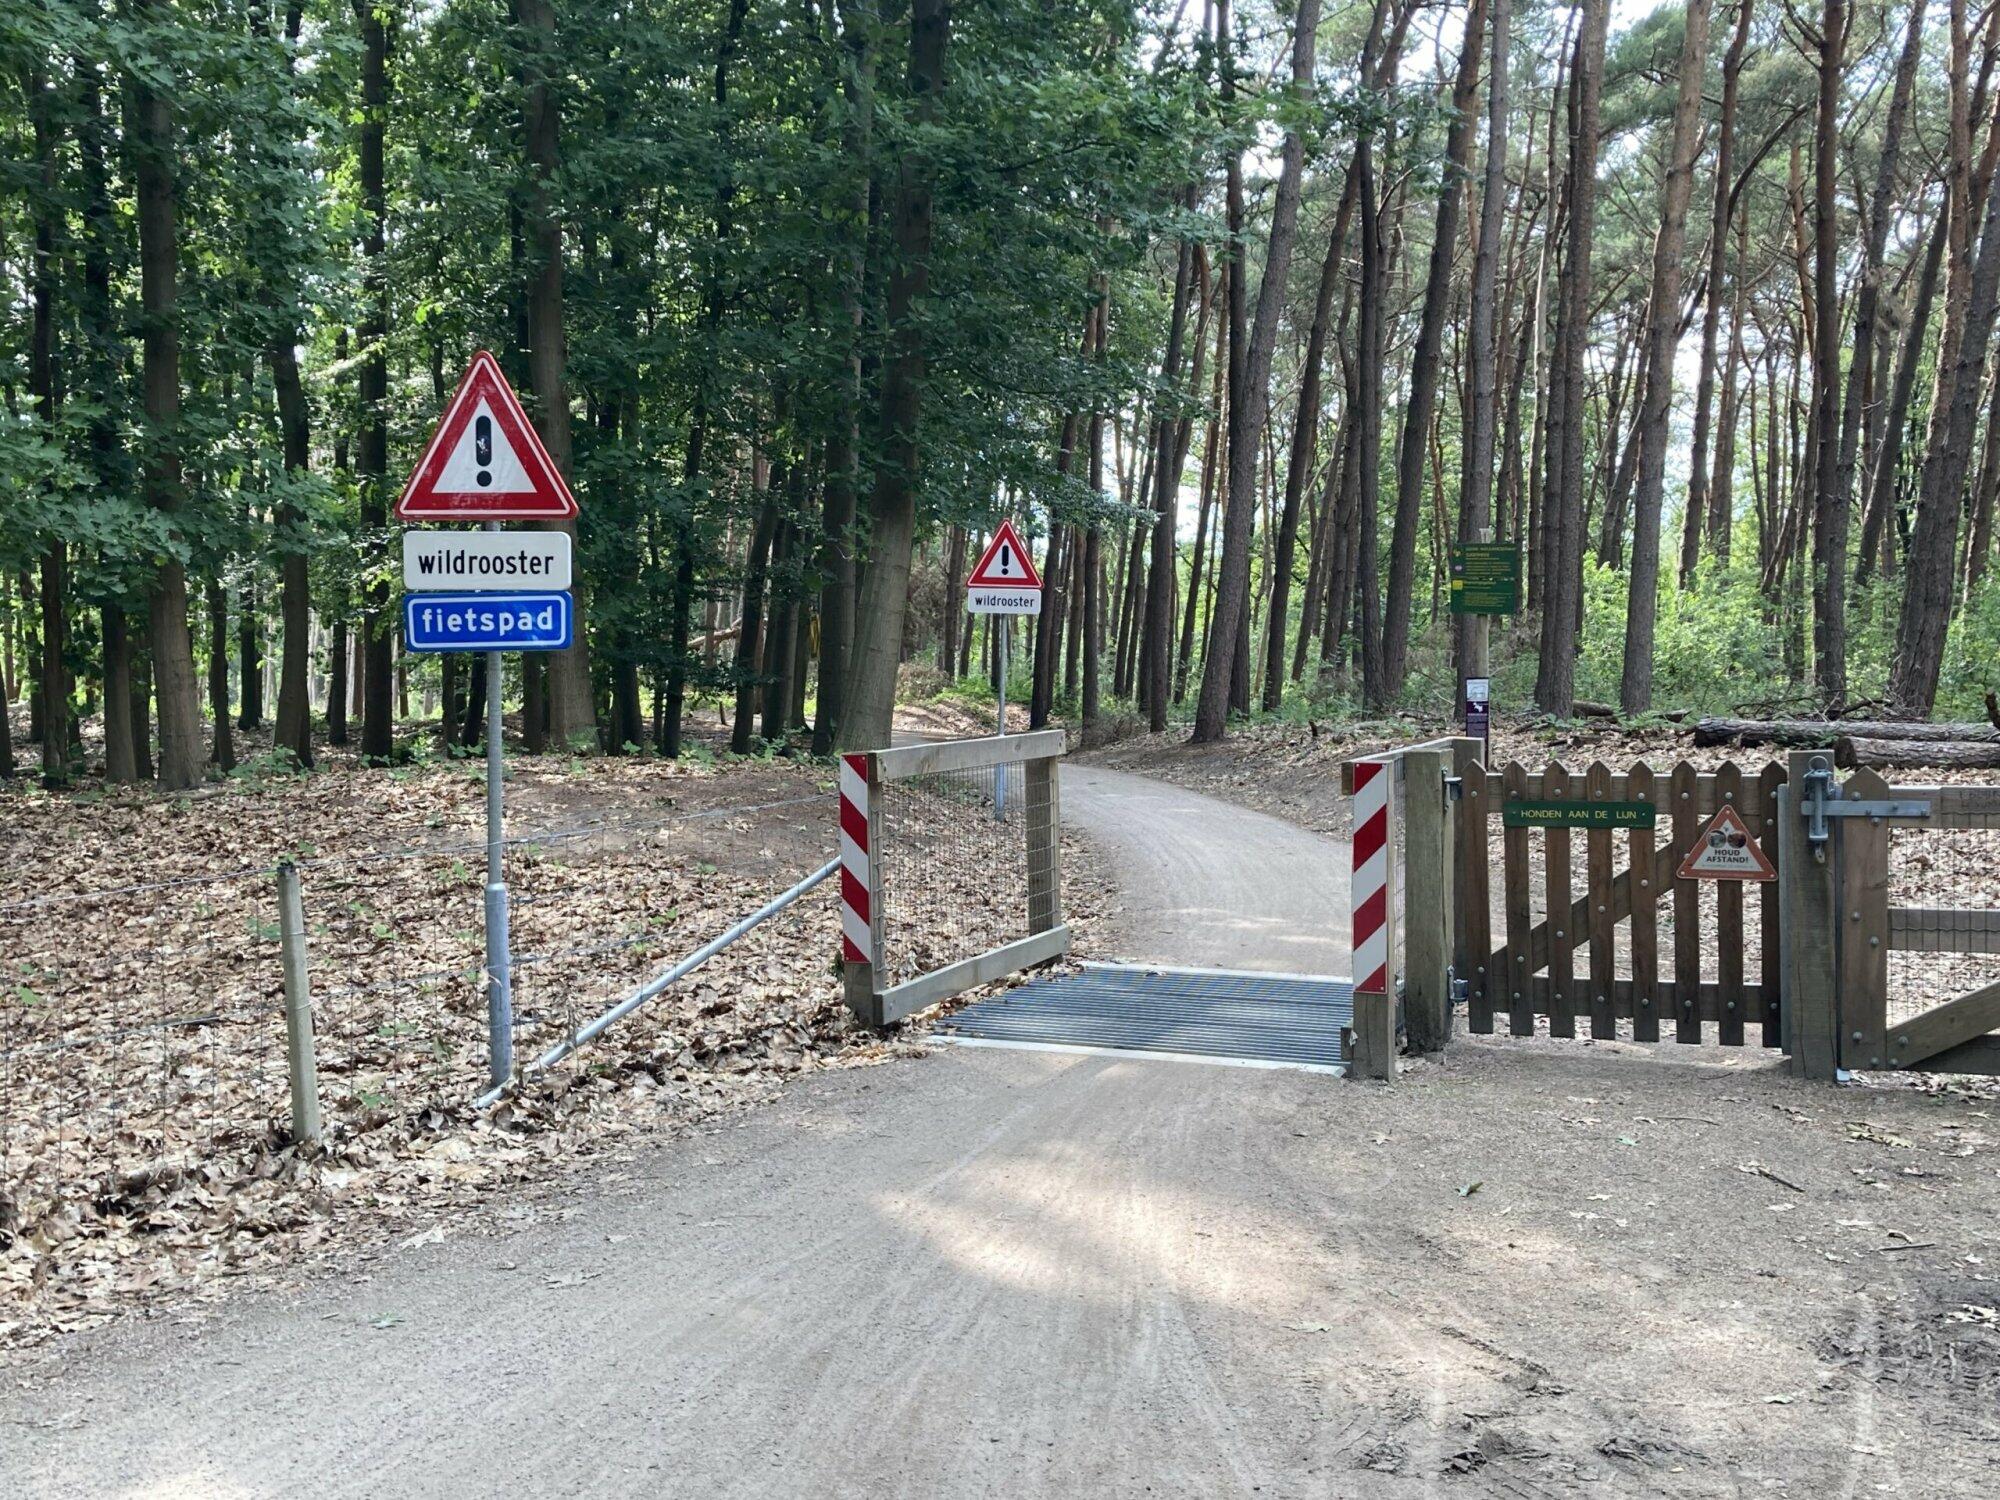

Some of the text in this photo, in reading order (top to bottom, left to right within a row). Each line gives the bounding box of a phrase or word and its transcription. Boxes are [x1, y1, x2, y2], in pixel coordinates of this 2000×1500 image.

[418, 549, 554, 574] wildrooster
[975, 595, 1035, 607] wildrooster
[422, 606, 553, 636] fietspad
[1521, 809, 1637, 819] HONDEN AAN DE LIJN
[1706, 856, 1749, 864] AFSTAND!
